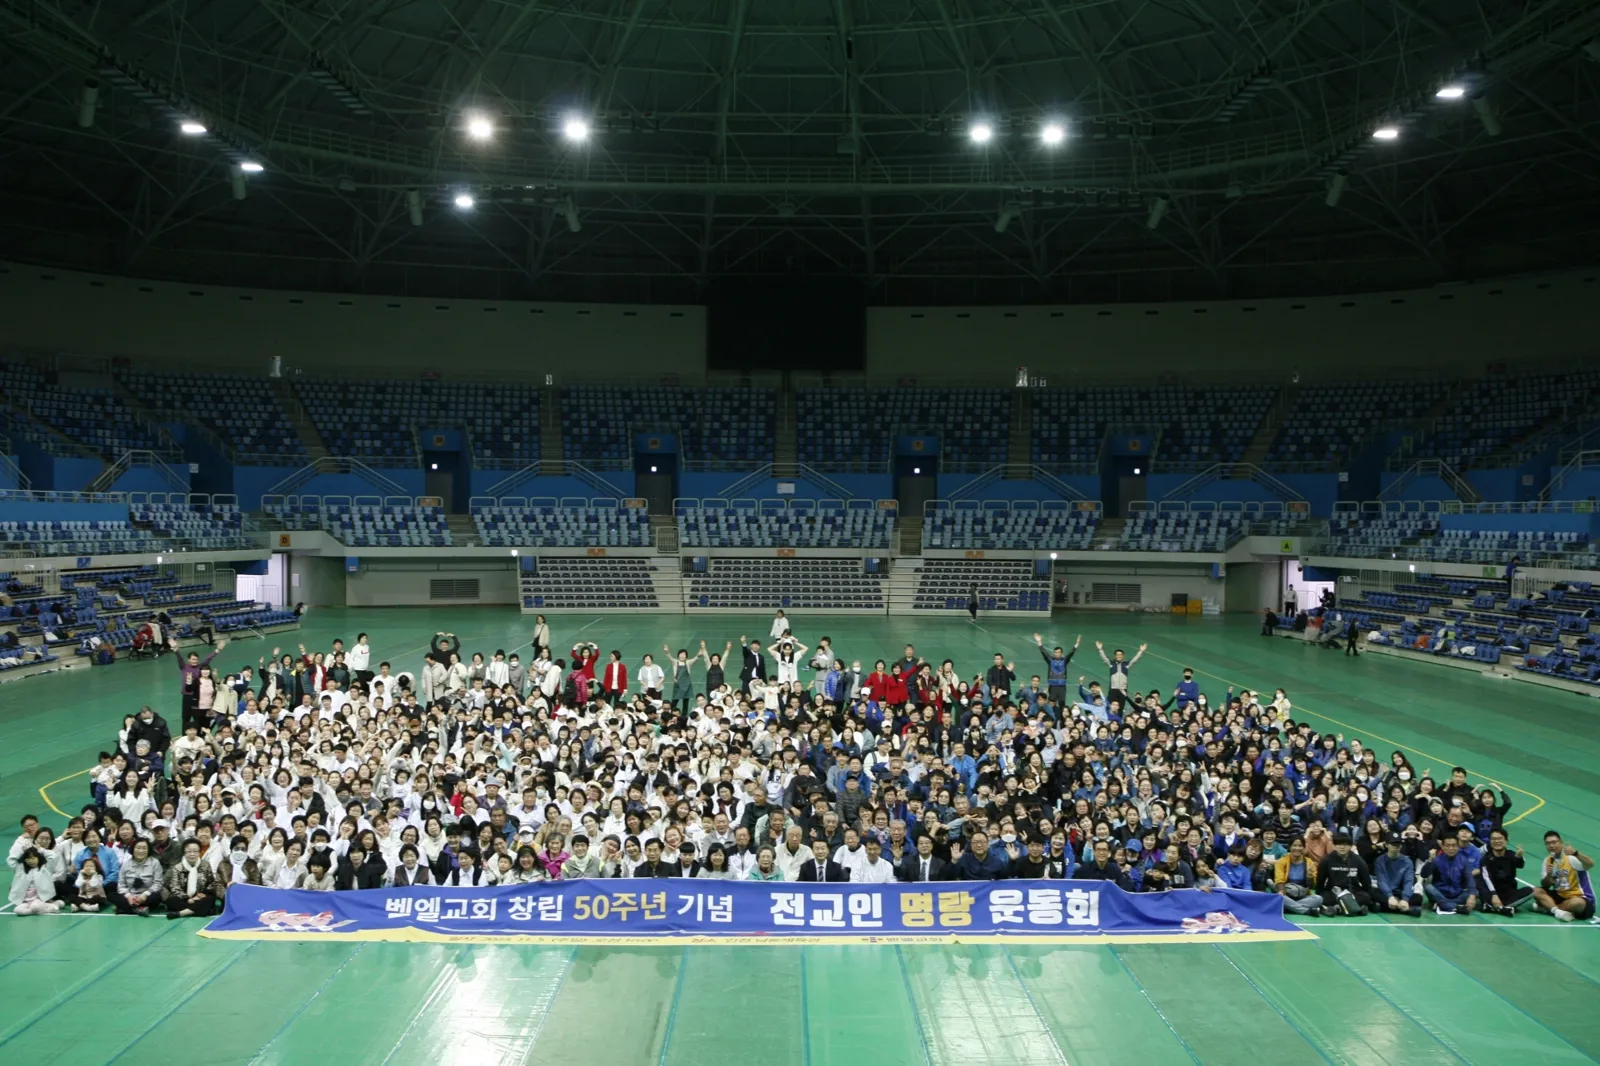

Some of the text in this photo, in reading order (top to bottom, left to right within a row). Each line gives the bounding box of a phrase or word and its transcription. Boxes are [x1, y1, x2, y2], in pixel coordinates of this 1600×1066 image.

[507, 895, 564, 922] 창립
[573, 891, 667, 922] 50주년
[677, 893, 733, 923] 기념
[770, 892, 884, 928] 전교인
[900, 891, 976, 927] 명랑
[989, 888, 1100, 926] 운동회
